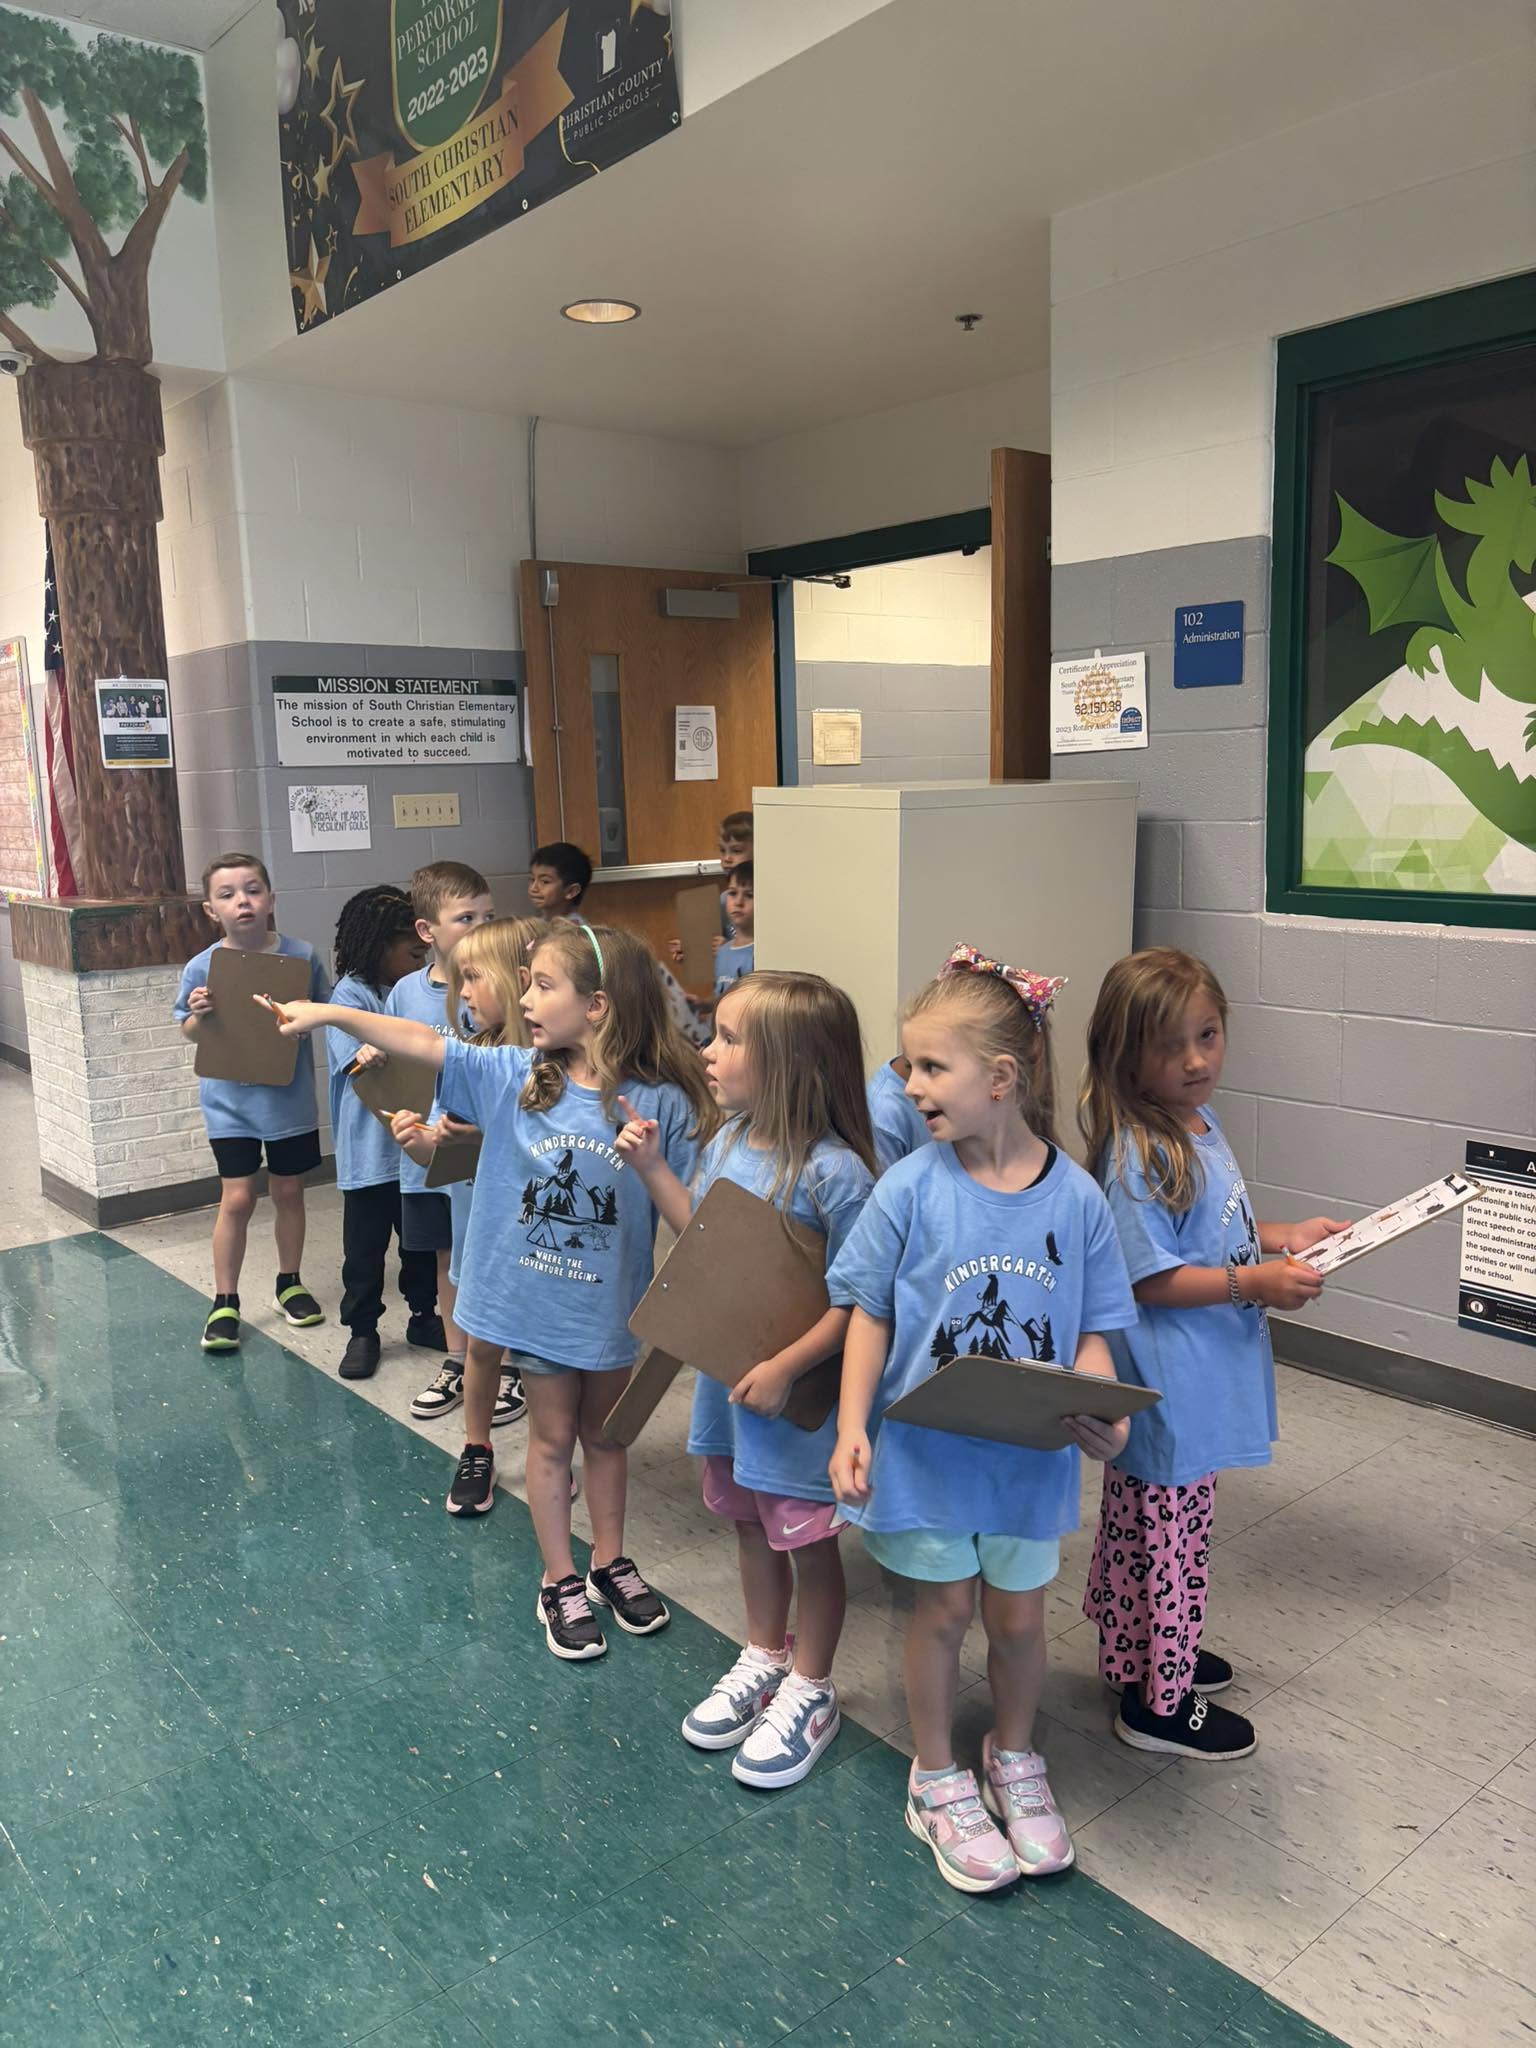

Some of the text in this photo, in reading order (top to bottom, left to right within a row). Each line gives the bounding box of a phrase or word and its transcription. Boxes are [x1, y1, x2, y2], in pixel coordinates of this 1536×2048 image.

[416, 10, 479, 74] SCHOOL
[407, 46, 488, 122] 2022-2023
[617, 58, 663, 97] COUNTY
[573, 87, 649, 141] PUBLIC SCHOOLS
[389, 104, 519, 211] SOUTH CHRISTIAN
[404, 148, 505, 234] ELEMENTARY
[1183, 612, 1204, 627] 102
[1182, 629, 1240, 644] Administration
[1058, 658, 1137, 675] Certificate of Appreciation
[317, 678, 480, 694] MISSION STATEMENT
[276, 699, 516, 714] The mission of South Christian Elementary
[1074, 700, 1122, 716] $2,150.38
[291, 715, 506, 729] School is to create a safe, stimulating
[1056, 726, 1072, 734] 2023
[1073, 723, 1094, 732] Rotary
[306, 732, 497, 743] environment in which each child is
[347, 746, 472, 758] motivated to succeed.
[530, 1134, 626, 1173] KINDERGARTEN
[1481, 1184, 1506, 1194] never
[1514, 1190, 1536, 1200] teach
[1478, 1196, 1510, 1209] ctioning
[1511, 1201, 1519, 1209] in
[1467, 1205, 1482, 1214] tion
[1484, 1208, 1492, 1216] at
[1499, 1212, 1522, 1222] public
[1523, 1217, 1536, 1226] sch
[1467, 1217, 1488, 1228] direct
[1489, 1222, 1515, 1233] speech
[1527, 1230, 1536, 1238] co
[1466, 1229, 1536, 1250] school administrato
[536, 1249, 583, 1269] WHERE THE
[1466, 1241, 1478, 1250] the
[1479, 1244, 1505, 1256] speech
[1517, 1251, 1536, 1262] cond
[519, 1255, 597, 1283] ADVENTURE BEGINS
[1465, 1253, 1497, 1266] activities
[1499, 1260, 1507, 1268] or
[1509, 1263, 1523, 1272] will
[943, 1254, 1058, 1294] KINDERGARTEN
[1465, 1264, 1514, 1282] of the school.
